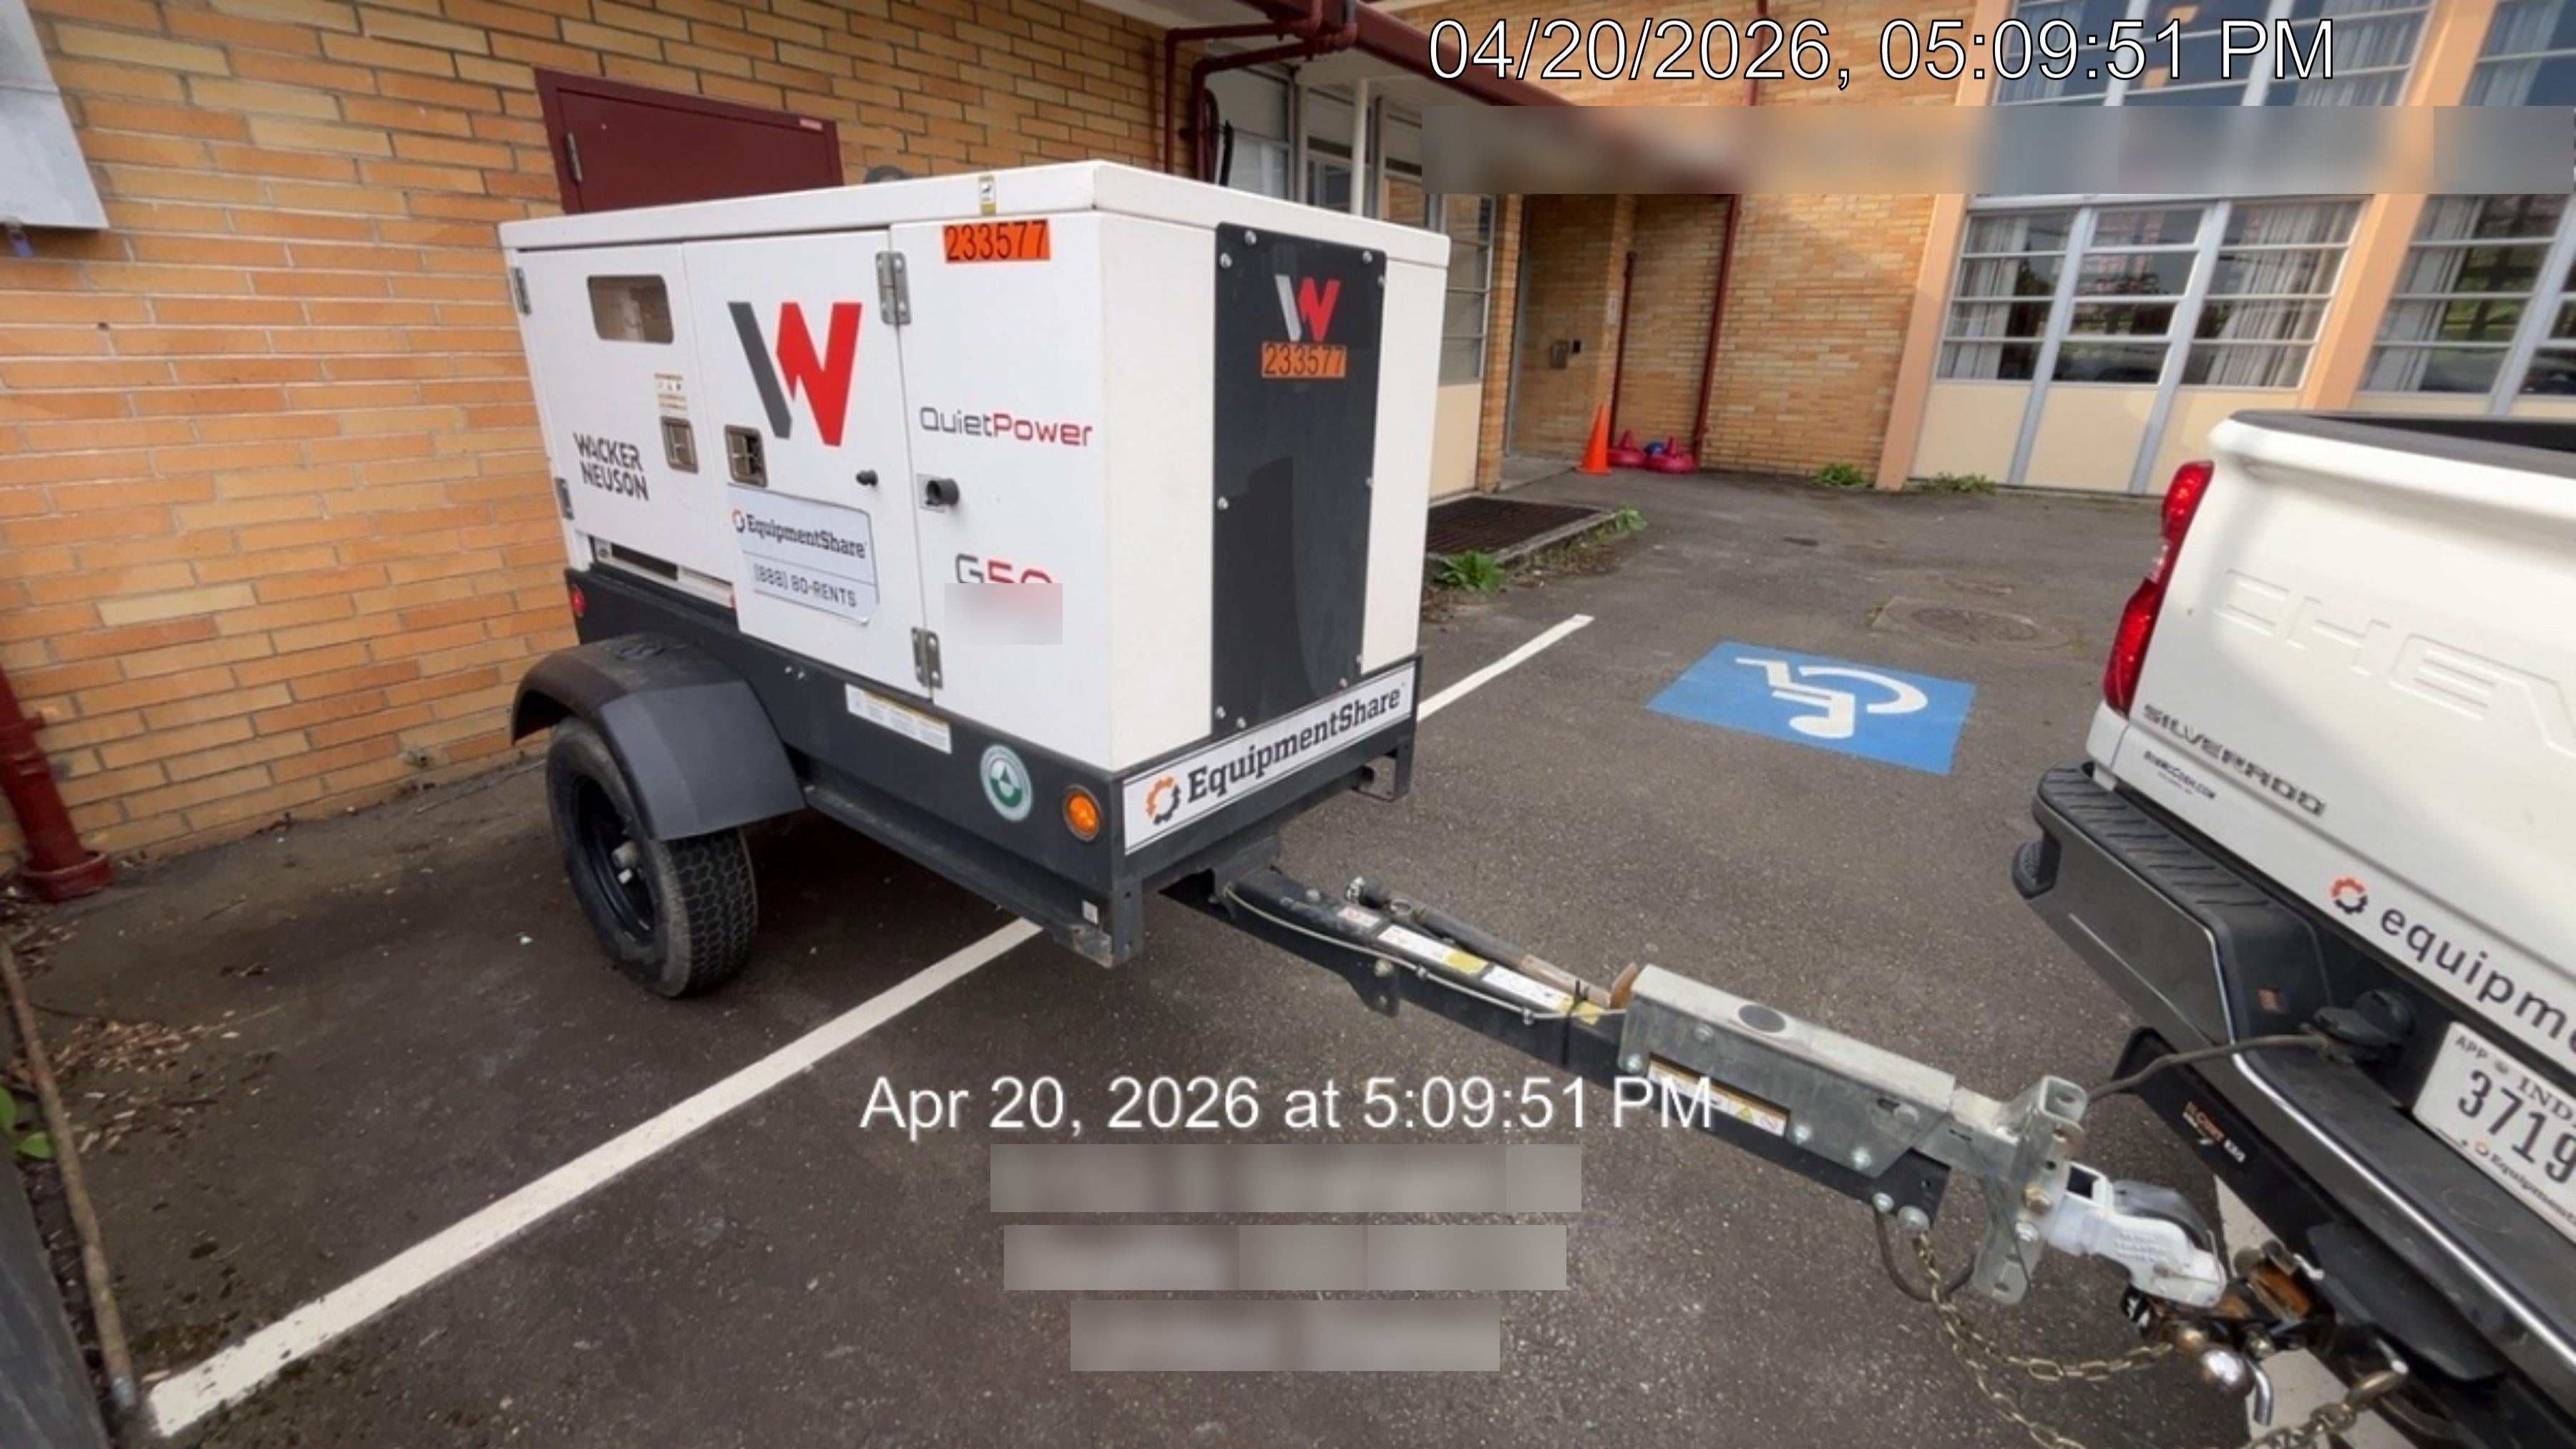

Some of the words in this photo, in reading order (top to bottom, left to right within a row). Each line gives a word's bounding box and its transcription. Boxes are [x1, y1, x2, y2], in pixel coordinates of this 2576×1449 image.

[944, 218, 1048, 262] 233577
[1264, 343, 1344, 375] 233577
[919, 406, 1093, 447] QuietPower
[572, 431, 643, 472] WACKER
[580, 461, 650, 502] NEUSON
[746, 514, 867, 558] EquipmentShare
[791, 574, 857, 608] 80-RENTS
[1186, 688, 1400, 804] EquipmentShare
[2143, 703, 2326, 817] SILVERADO
[2380, 908, 2576, 1055] equipm
